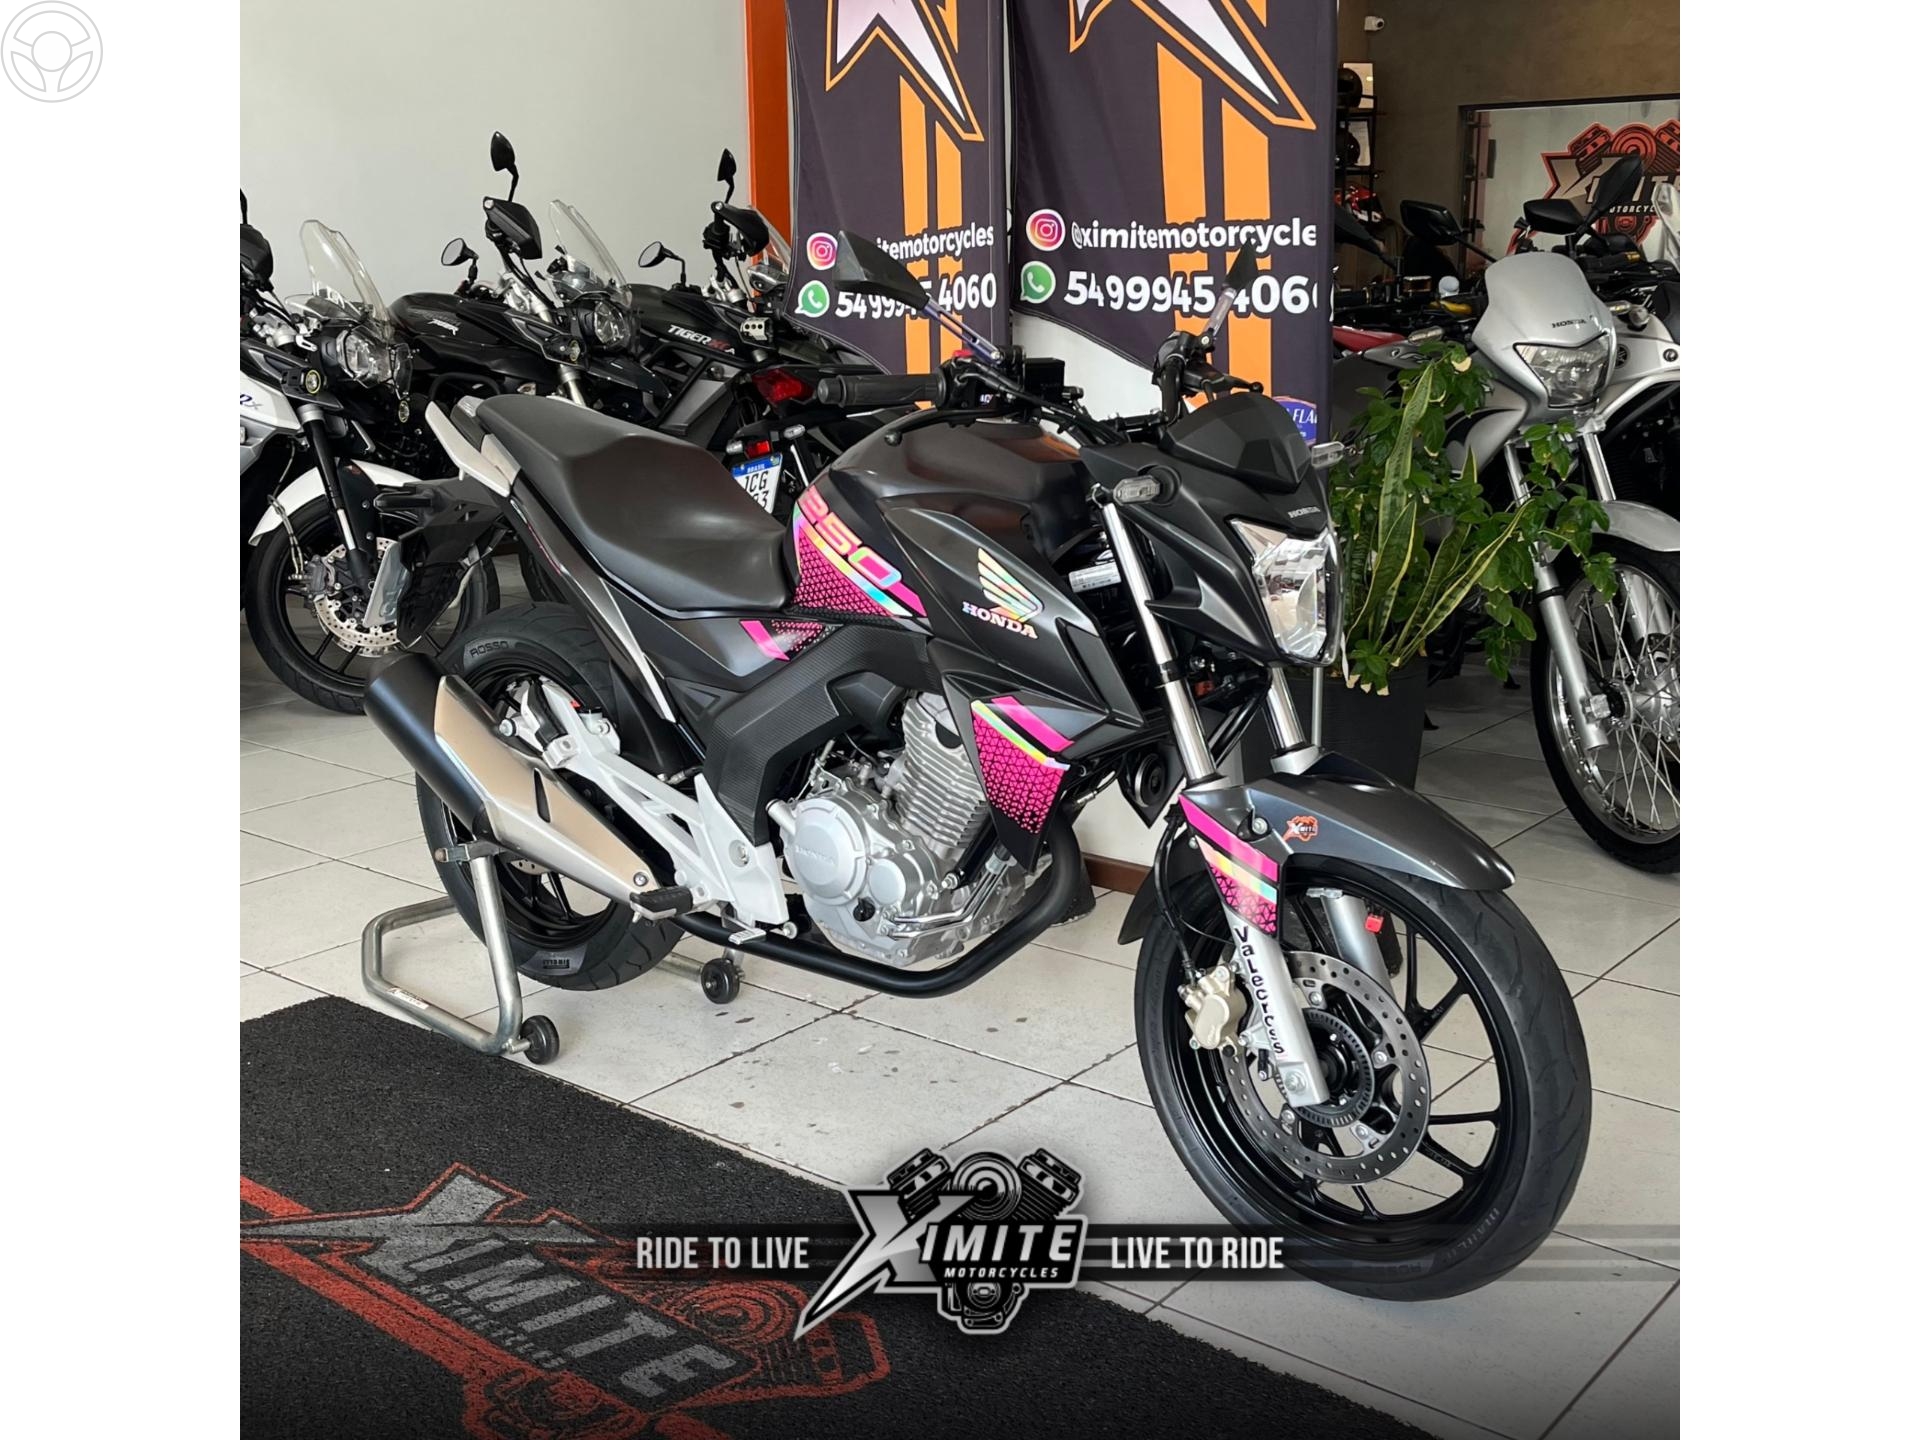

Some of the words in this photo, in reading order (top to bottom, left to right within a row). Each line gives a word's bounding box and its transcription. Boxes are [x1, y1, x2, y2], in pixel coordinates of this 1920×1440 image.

[835, 280, 933, 319] 54999
[938, 272, 997, 312] 4060
[1064, 271, 1215, 313] 5499945
[1233, 275, 1317, 314] 406
[668, 324, 712, 345] TIGER
[1288, 506, 1320, 519] HONDA
[797, 484, 902, 590] 250
[962, 601, 1038, 640] HONDA
[470, 640, 509, 658] ROSSO
